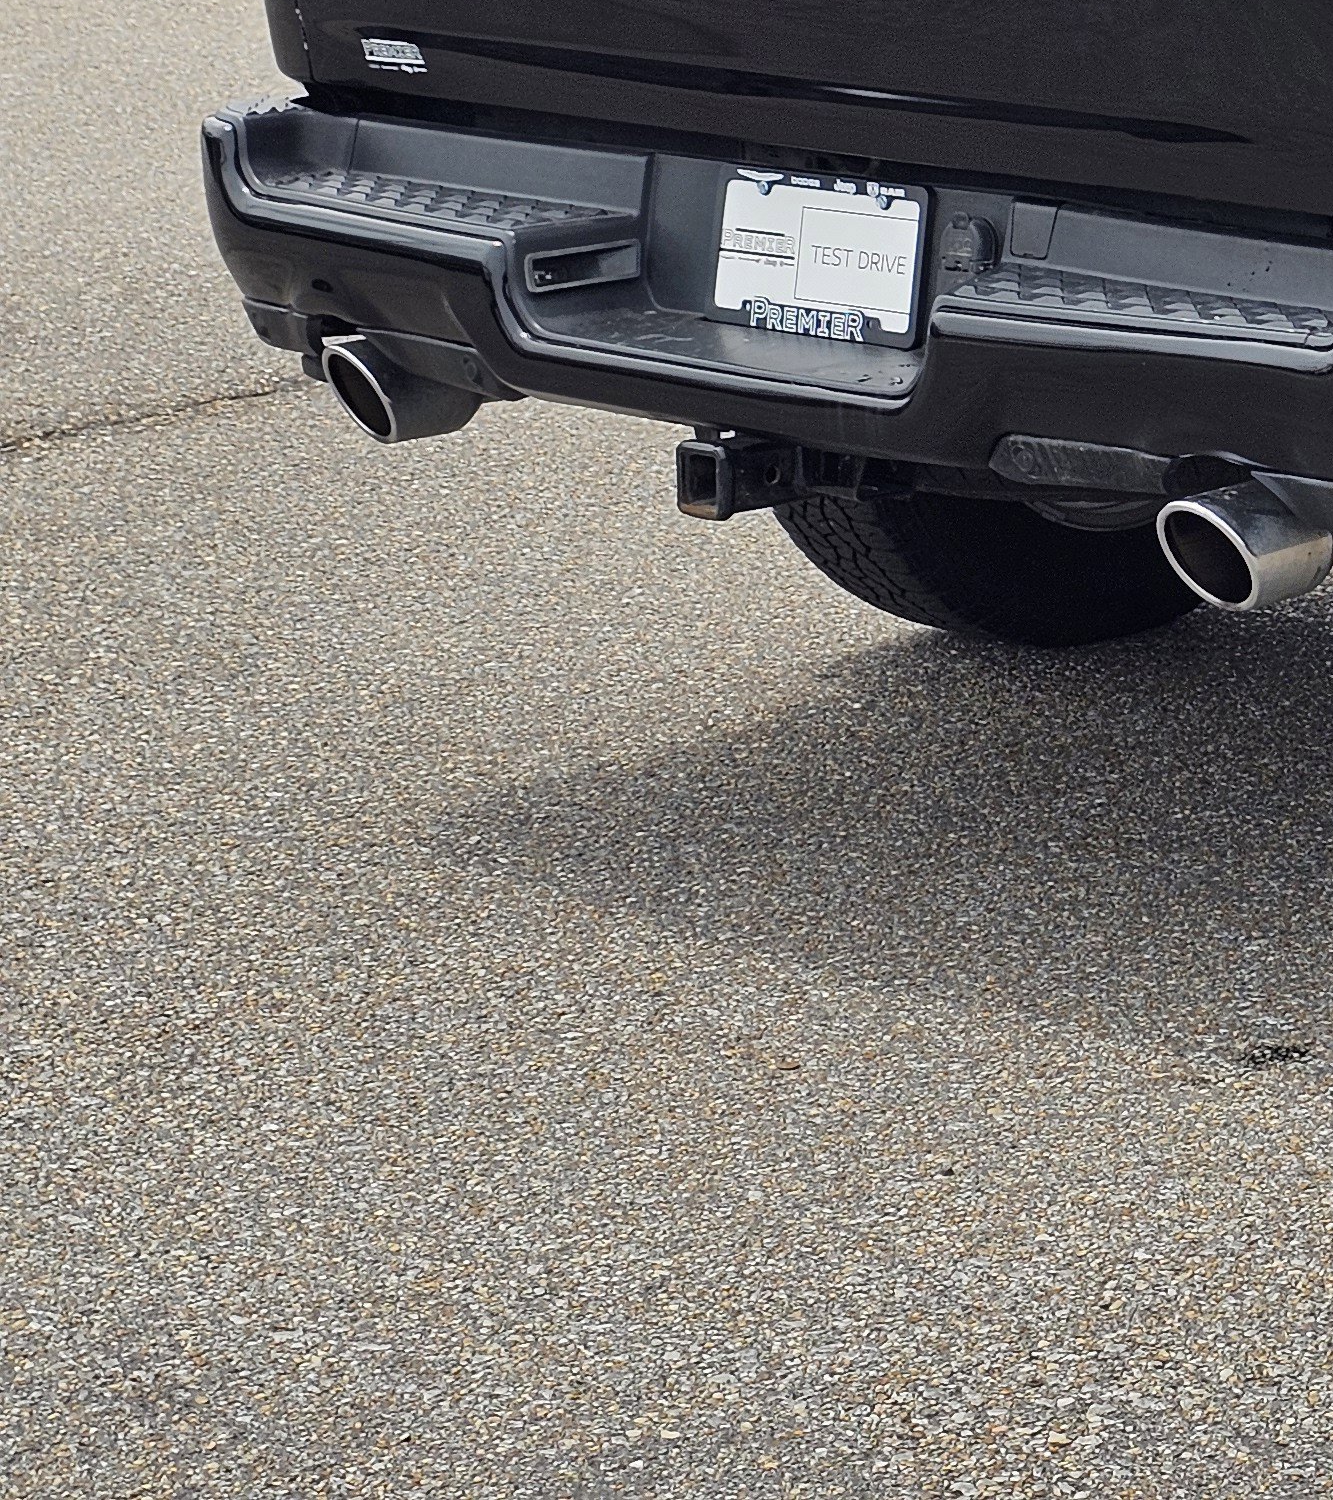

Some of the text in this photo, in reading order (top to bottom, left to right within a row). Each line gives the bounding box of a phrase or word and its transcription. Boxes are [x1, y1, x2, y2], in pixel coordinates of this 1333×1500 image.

[721, 228, 796, 255] PREMIER
[811, 244, 854, 268] TEST
[857, 250, 908, 275] DRIVE
[749, 296, 864, 342] PREMIER
